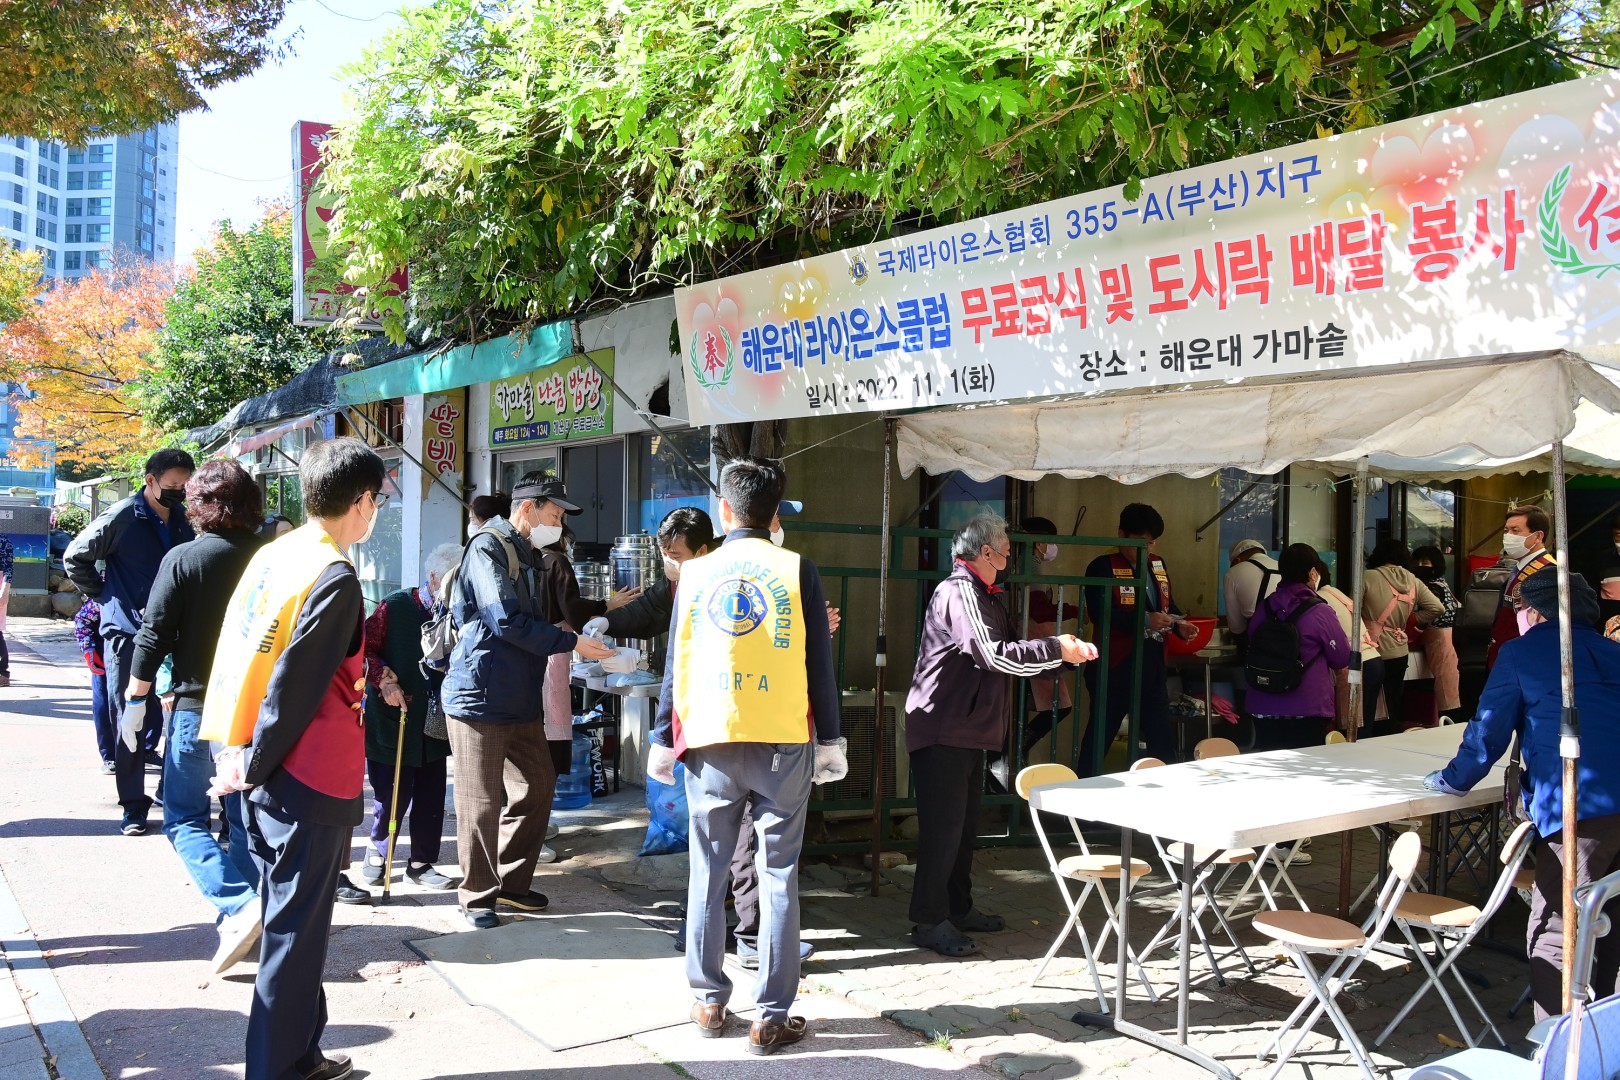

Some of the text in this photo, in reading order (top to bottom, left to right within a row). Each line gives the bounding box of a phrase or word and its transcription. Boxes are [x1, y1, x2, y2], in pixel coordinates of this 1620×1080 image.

[877, 214, 1051, 277] 국제라이온스협회
[741, 189, 1524, 374] 해운대라이온스클럽 무료급식 및 도시락 배달 봉사
[704, 332, 725, 381] 奉
[1079, 348, 1128, 382] 장소
[1160, 334, 1242, 373] 해운대
[1253, 322, 1348, 365] 가마솥
[538, 376, 565, 410] 나눔
[568, 367, 600, 409] 밥상
[806, 383, 838, 409] 일시
[951, 363, 995, 396] 1(화)
[504, 427, 519, 440] 화요일
[766, 577, 792, 616] LIONS
[773, 618, 792, 649] CLUB
